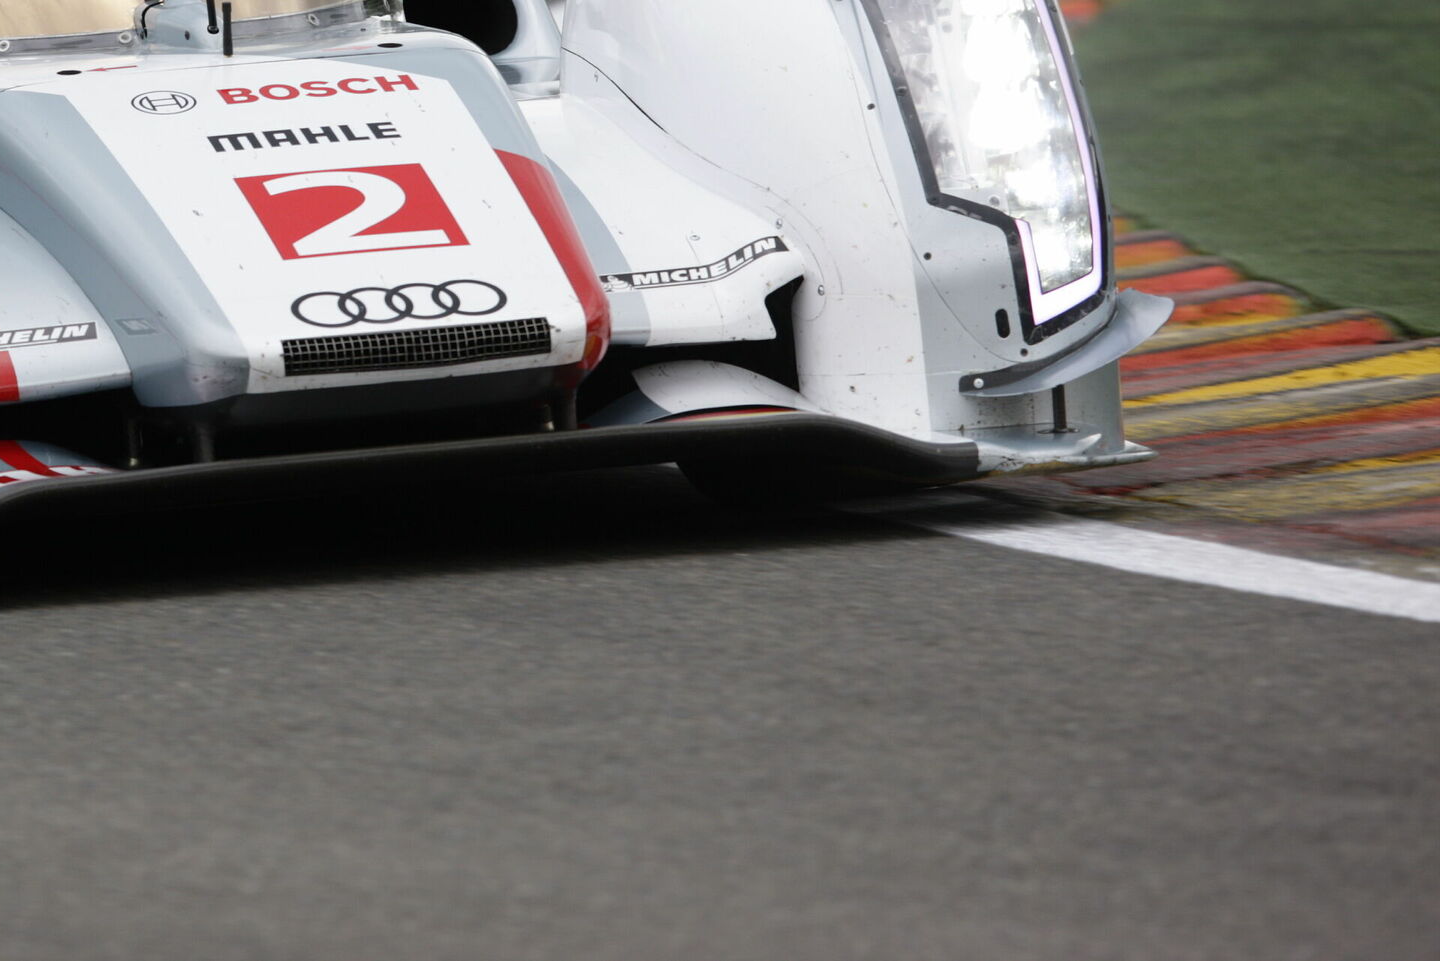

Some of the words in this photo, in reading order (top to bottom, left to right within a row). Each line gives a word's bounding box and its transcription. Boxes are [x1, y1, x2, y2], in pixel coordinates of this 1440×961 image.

[216, 74, 420, 105] BOSCH
[207, 122, 402, 153] MAHLE
[262, 171, 451, 257] 2
[632, 237, 776, 287] MICHELIN
